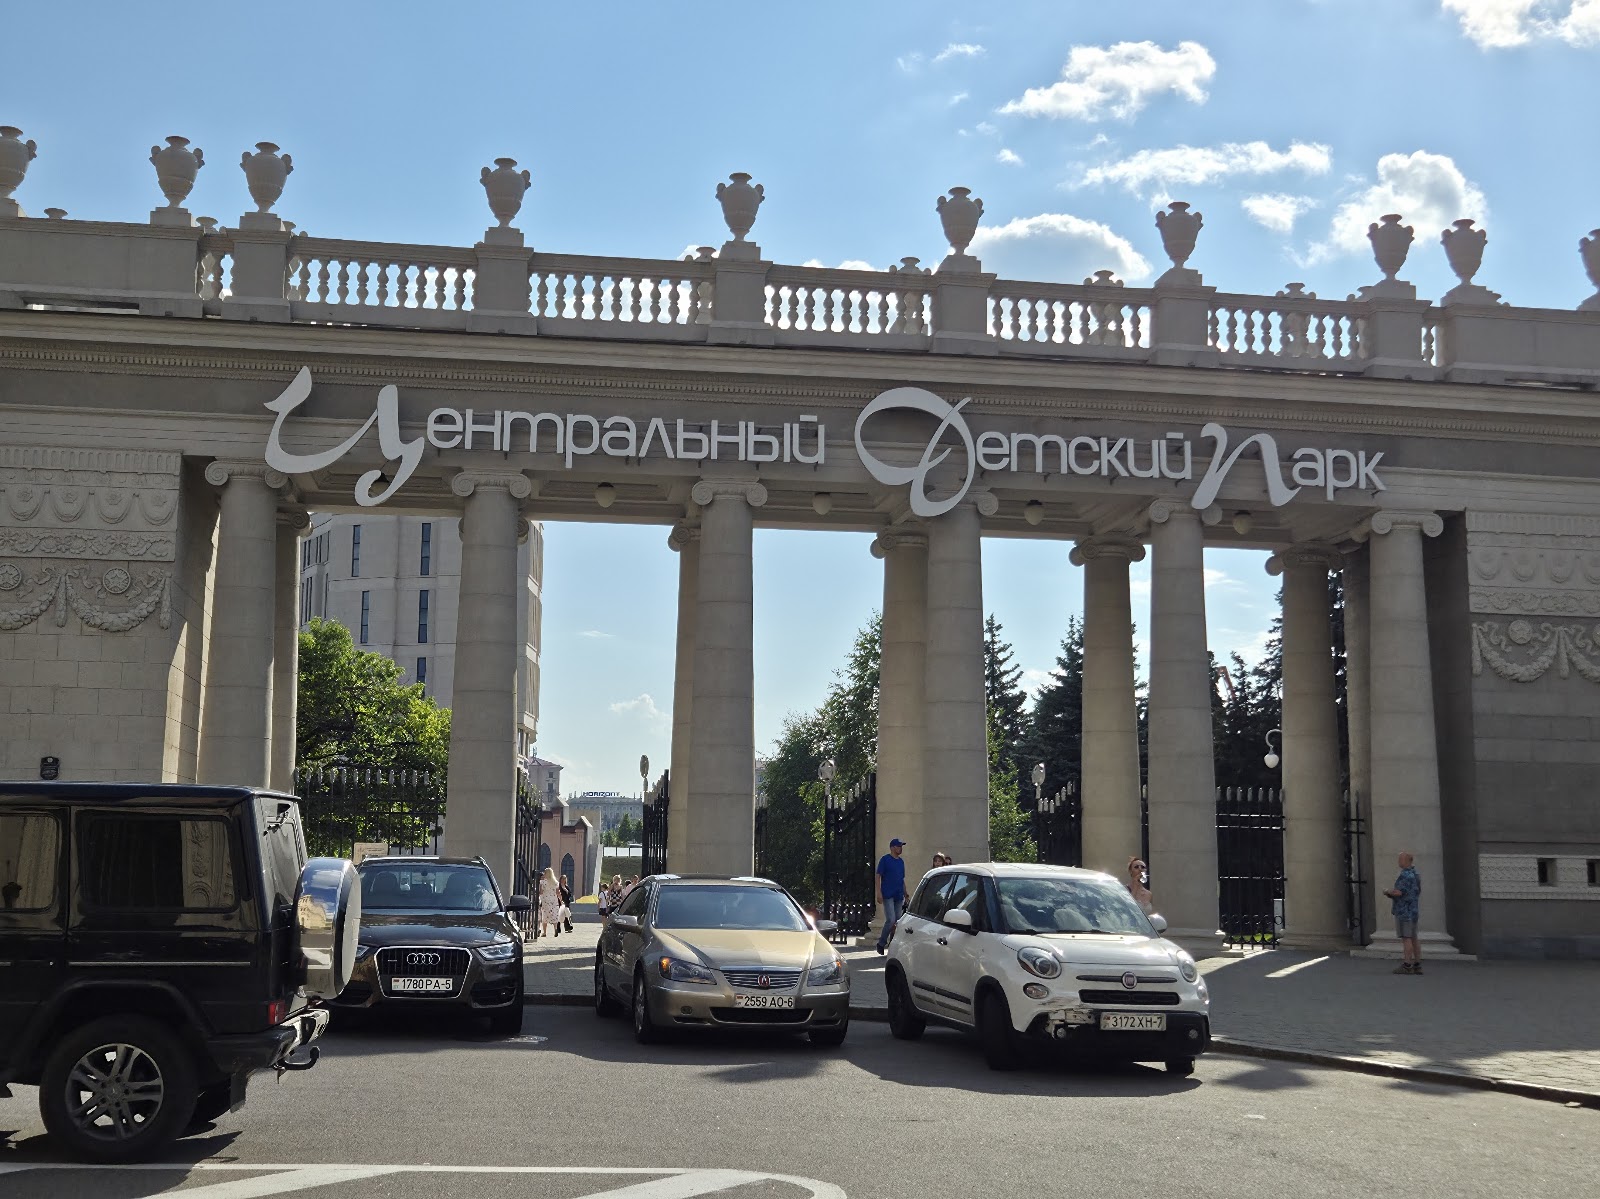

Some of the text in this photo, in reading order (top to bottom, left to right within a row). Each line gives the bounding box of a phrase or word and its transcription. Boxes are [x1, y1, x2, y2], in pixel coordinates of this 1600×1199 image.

[263, 365, 1387, 517] Центральный Детский Парк
